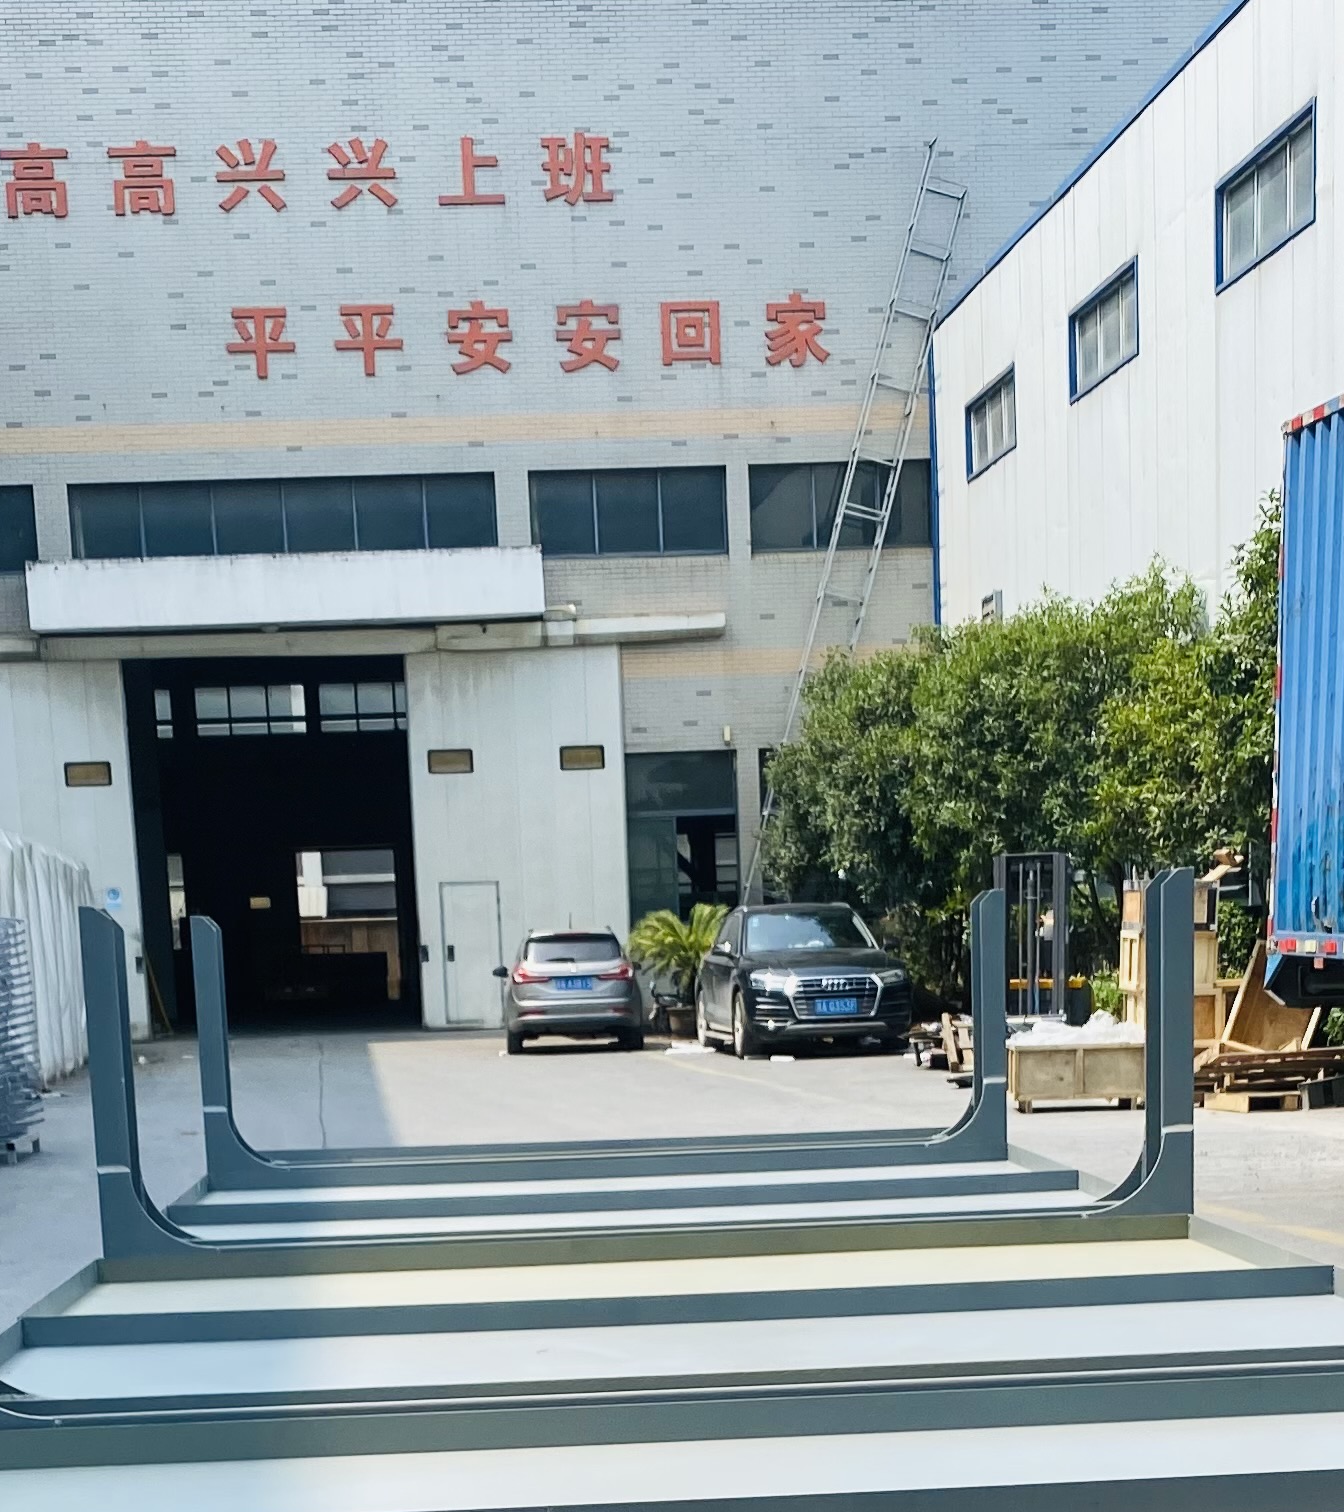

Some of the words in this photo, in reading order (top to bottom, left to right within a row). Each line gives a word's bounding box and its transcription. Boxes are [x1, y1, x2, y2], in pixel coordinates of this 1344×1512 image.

[225, 293, 832, 379] 平平安安回家
